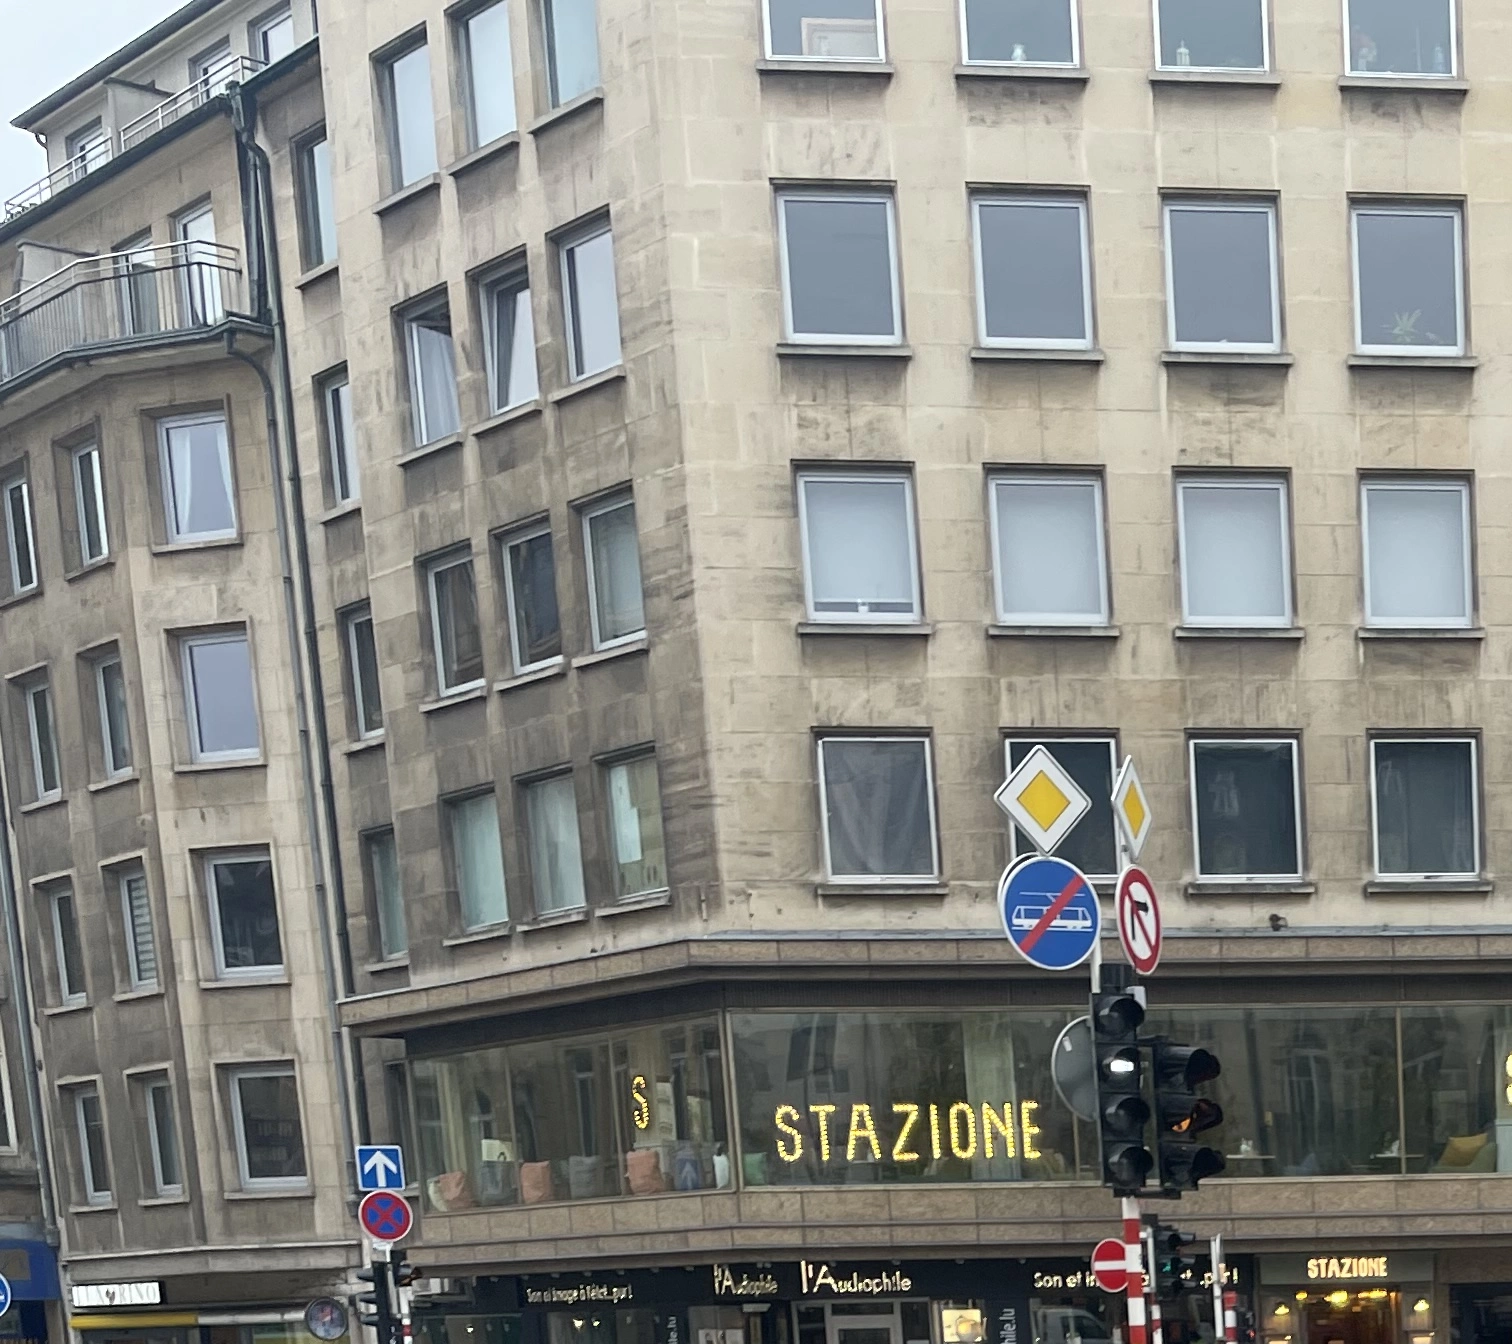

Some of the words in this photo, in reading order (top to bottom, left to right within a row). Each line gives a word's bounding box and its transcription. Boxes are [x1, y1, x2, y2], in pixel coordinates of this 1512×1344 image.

[632, 1075, 648, 1130] S
[775, 1101, 1042, 1163] STAZIONE
[801, 1260, 912, 1295] l'Audiophile
[1034, 1271, 1061, 1289] Son
[1063, 1270, 1082, 1288] et
[1307, 1256, 1389, 1279] STAZIONE
